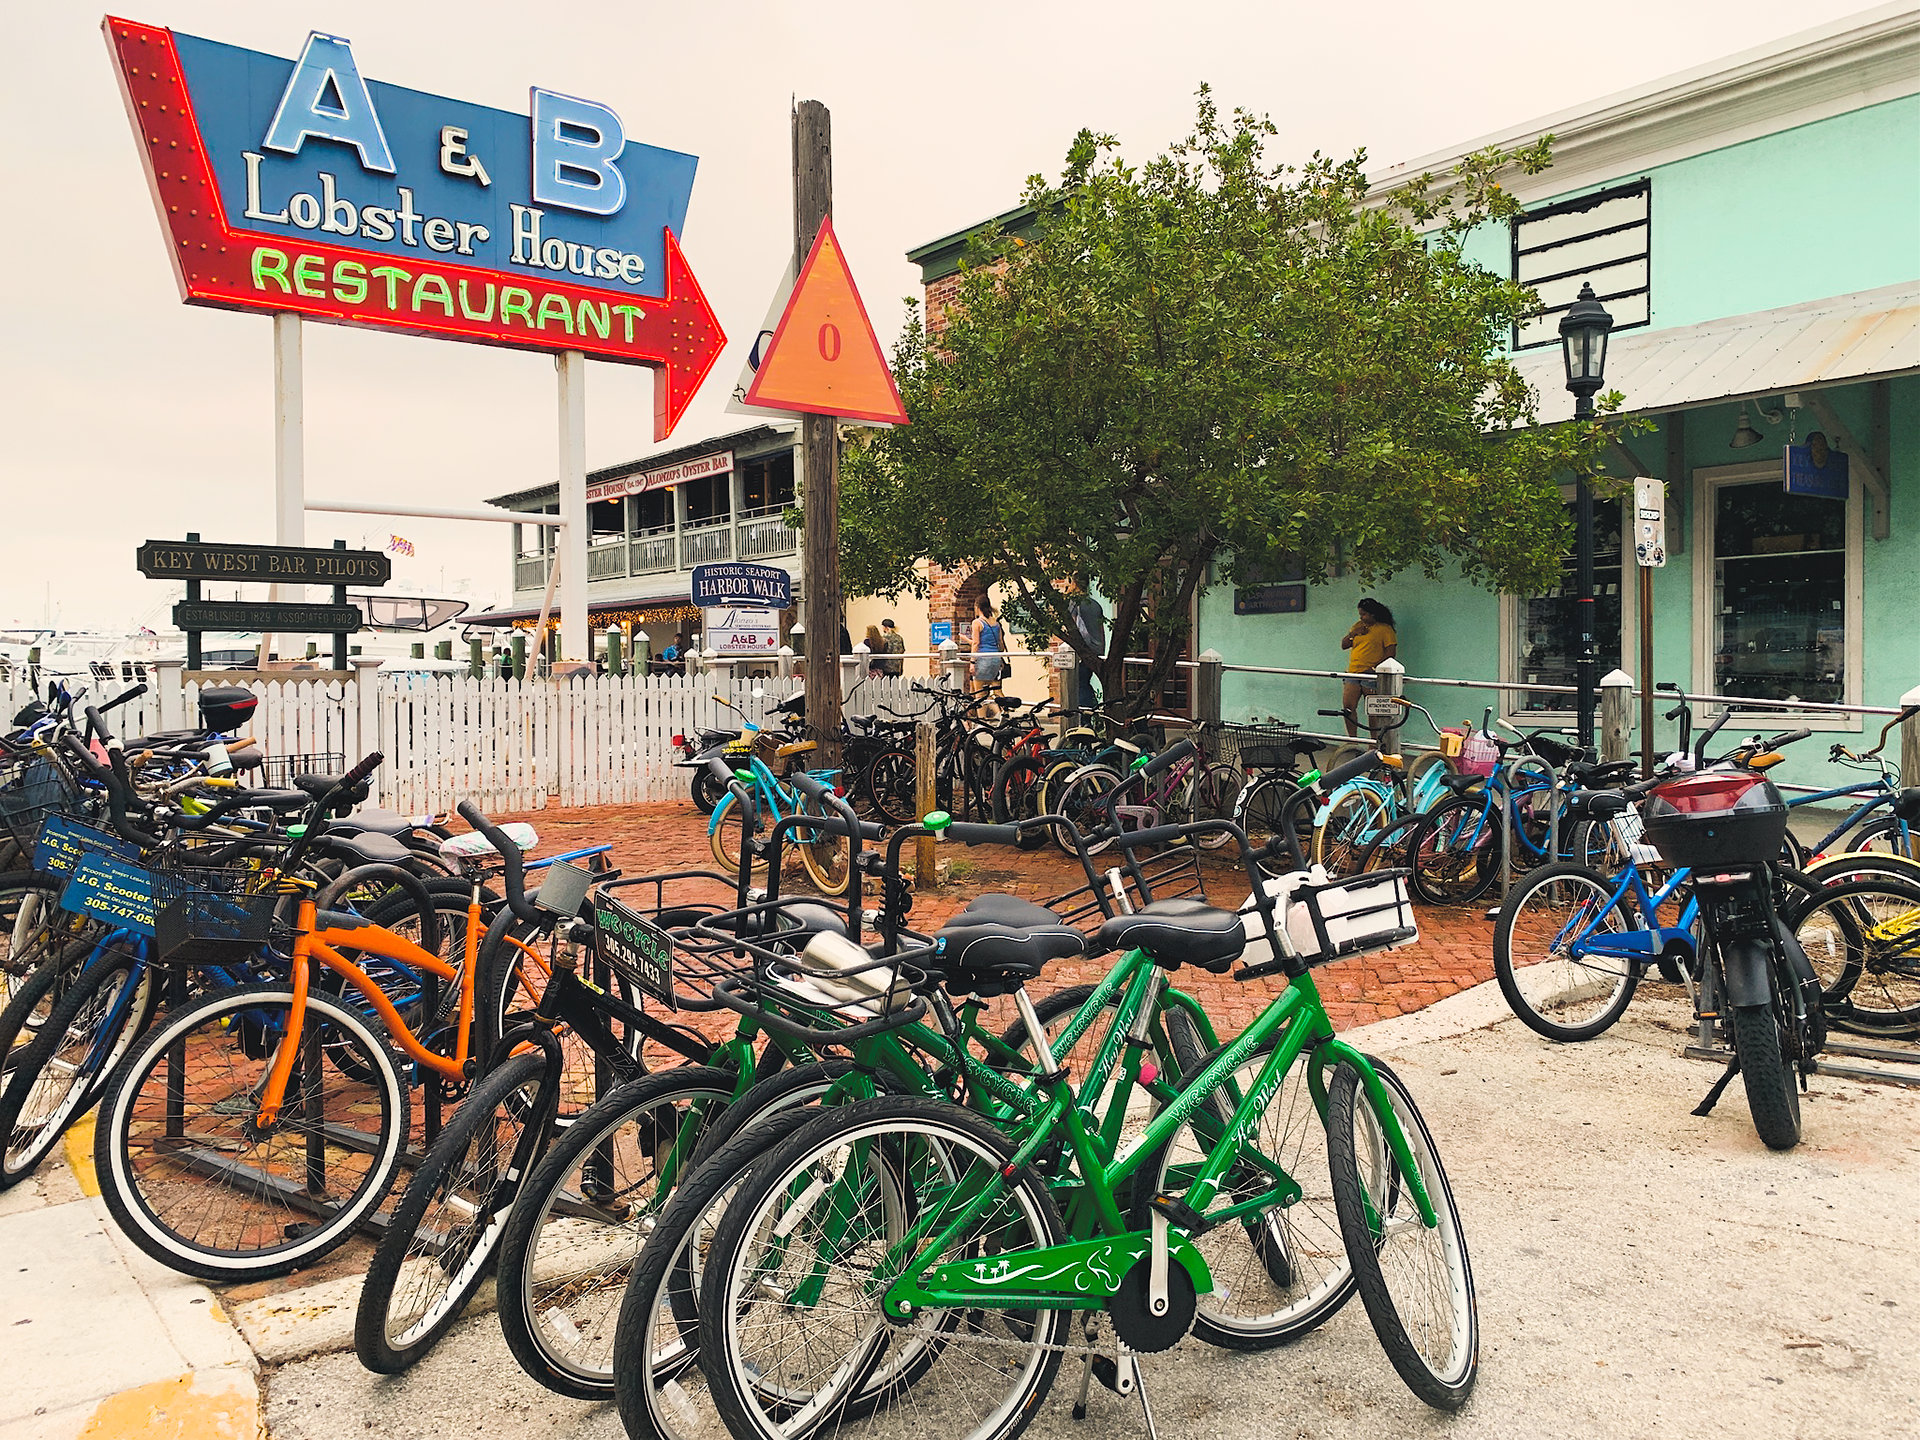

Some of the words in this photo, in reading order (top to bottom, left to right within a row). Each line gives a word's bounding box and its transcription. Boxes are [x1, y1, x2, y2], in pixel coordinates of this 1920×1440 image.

[261, 30, 397, 175] A
[440, 125, 492, 187] &
[529, 85, 627, 216] B
[241, 151, 490, 257] Lobster
[509, 202, 646, 285] House
[251, 246, 646, 345] RESTAURANT
[647, 468, 681, 486] ALONZO'S
[682, 461, 711, 479] OYSTER
[711, 455, 728, 471] BAR
[603, 482, 625, 496] HOUSE
[152, 550, 195, 570] KEY
[202, 552, 260, 572] WEST
[268, 554, 307, 574] BAR
[314, 557, 380, 577] PILOTS
[704, 566, 743, 578] HISTORIC
[745, 567, 781, 580] SEAPORT
[699, 577, 750, 598] HARBOR
[751, 578, 787, 600] WALK
[185, 610, 246, 623] ESTABLISHED
[250, 611, 271, 623] 1829
[276, 611, 329, 624] ASSOCIATED
[332, 613, 353, 624] 1902
[730, 634, 757, 645] A&B
[41, 836, 59, 849] J.G.
[46, 828, 69, 841] SCOOTERS
[81, 866, 113, 881] SCOOTERS
[76, 874, 100, 888] J.G.
[103, 882, 151, 904] Scooter
[96, 891, 112, 902] FREE
[111, 895, 137, 909] DELIVERY
[604, 933, 661, 985] 305.294.7433
[1113, 1007, 1136, 1045] West
[1231, 1112, 1259, 1154] Key
[1253, 1068, 1283, 1112] West
